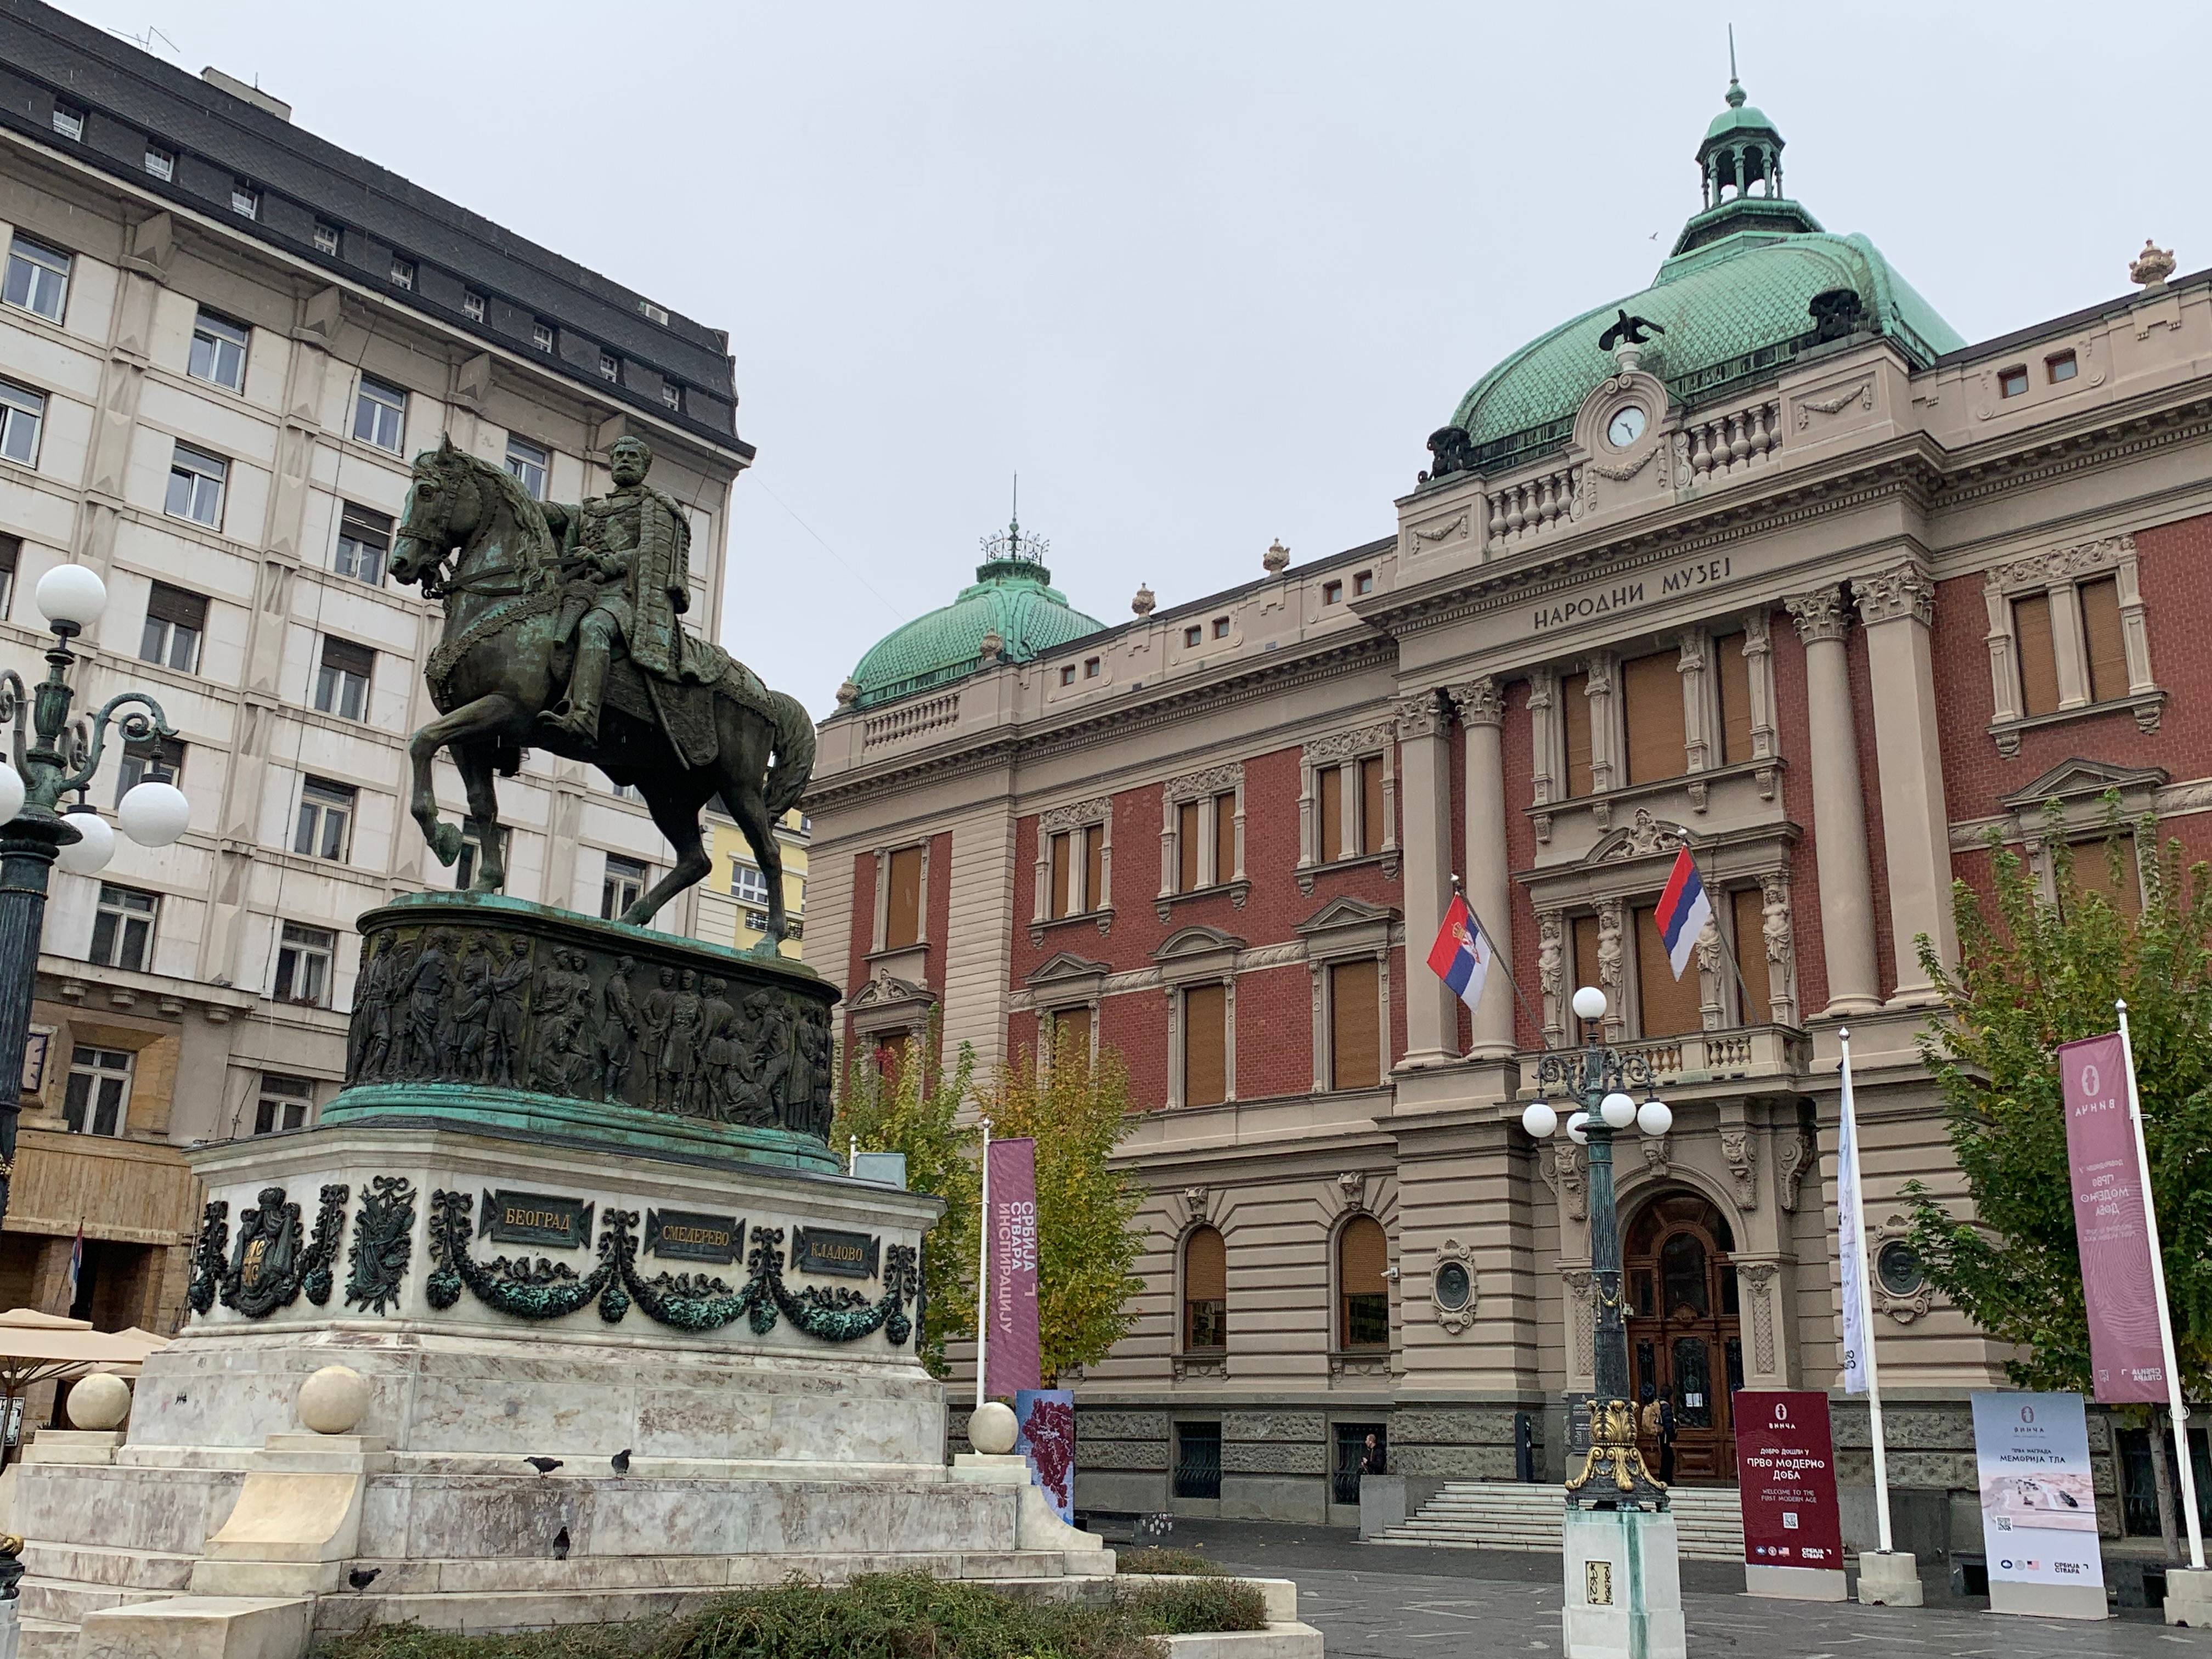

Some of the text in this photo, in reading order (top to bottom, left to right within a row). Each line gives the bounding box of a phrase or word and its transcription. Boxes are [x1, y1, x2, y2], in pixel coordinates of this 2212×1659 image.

[1534, 557, 1730, 629] НАРОДНИ МУЗЕЈ
[505, 1207, 571, 1231] БЕОГРАД
[663, 1224, 729, 1246] СМЕДЕРЕВО
[1010, 1201, 1022, 1271] СТВАРА
[1022, 1201, 1036, 1272] СРБИЈА
[811, 1242, 863, 1262] КЛАДОВО
[998, 1203, 1012, 1334] ИНСПИРАЦИЈУ
[1747, 1458, 1825, 1470] ПРВО МОДЕРНО
[2000, 1455, 2066, 1464] МЕМОРИЈА ТЛА
[1773, 1470, 1801, 1481] ДОБА
